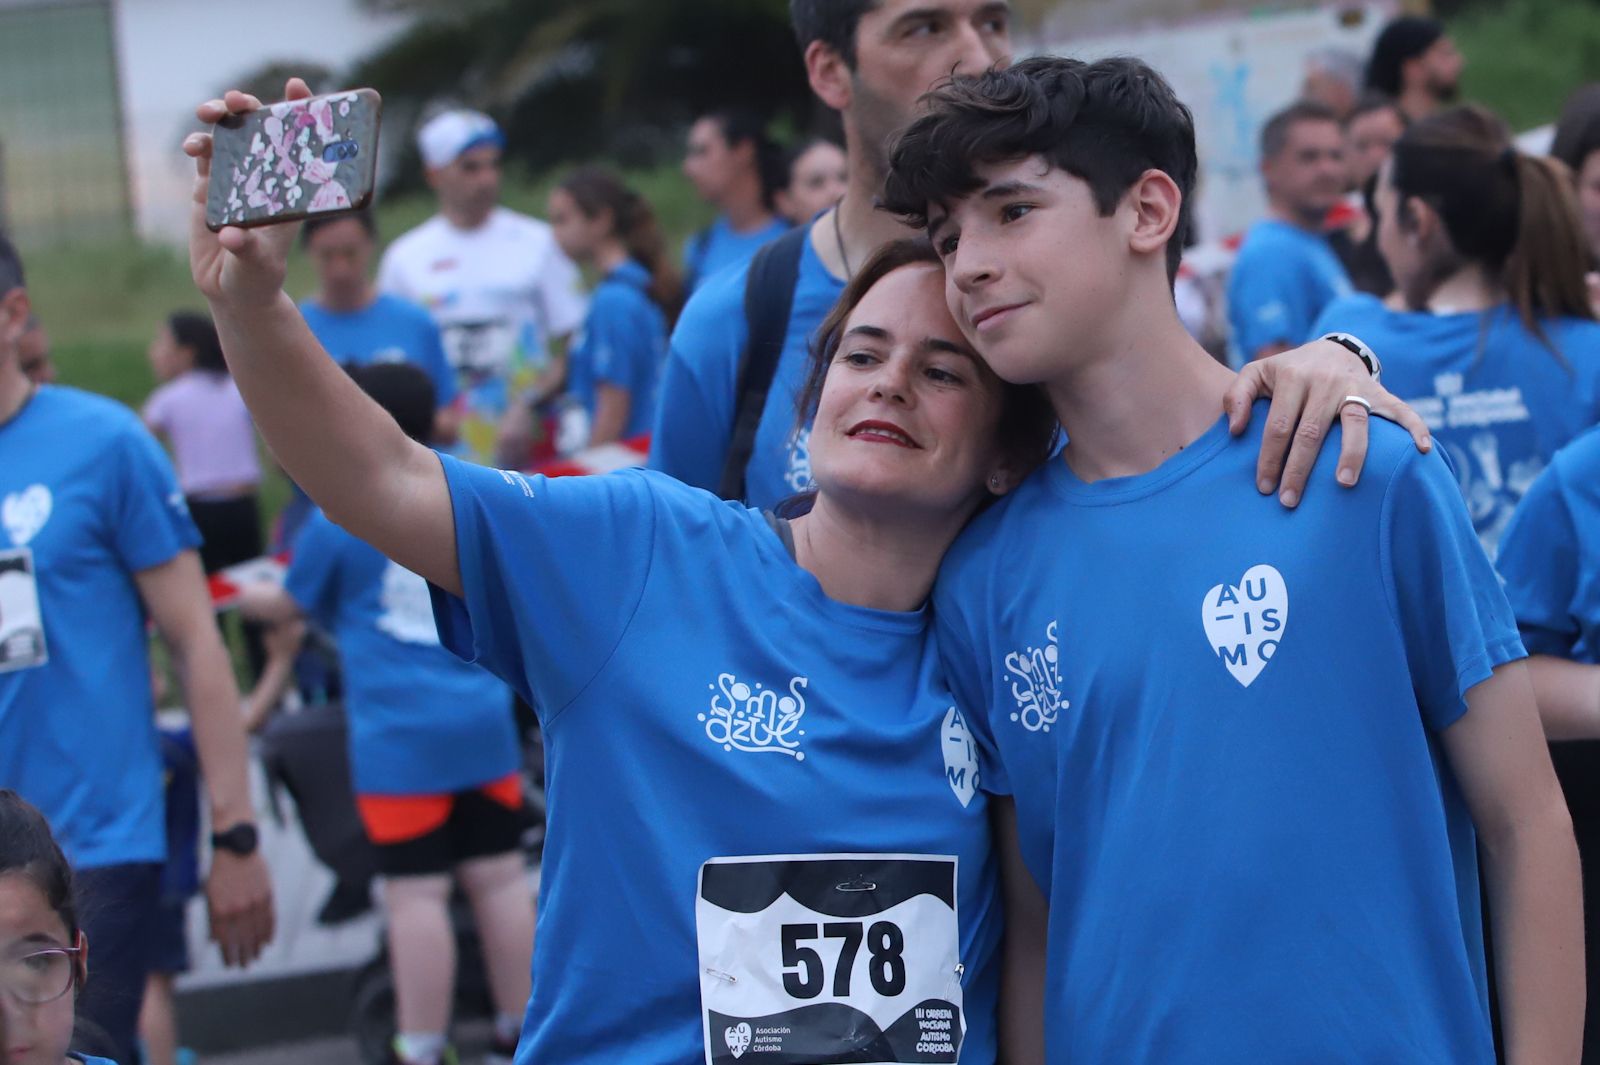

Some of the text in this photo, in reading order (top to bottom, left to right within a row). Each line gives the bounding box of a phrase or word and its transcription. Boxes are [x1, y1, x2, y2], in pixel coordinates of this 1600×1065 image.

[781, 921, 906, 999] 578
[915, 1008, 953, 1019] III CARRERA
[918, 1020, 951, 1030] NOCTURNA
[920, 1032, 951, 1041] AUTISMO
[753, 1044, 782, 1052] Córdoba
